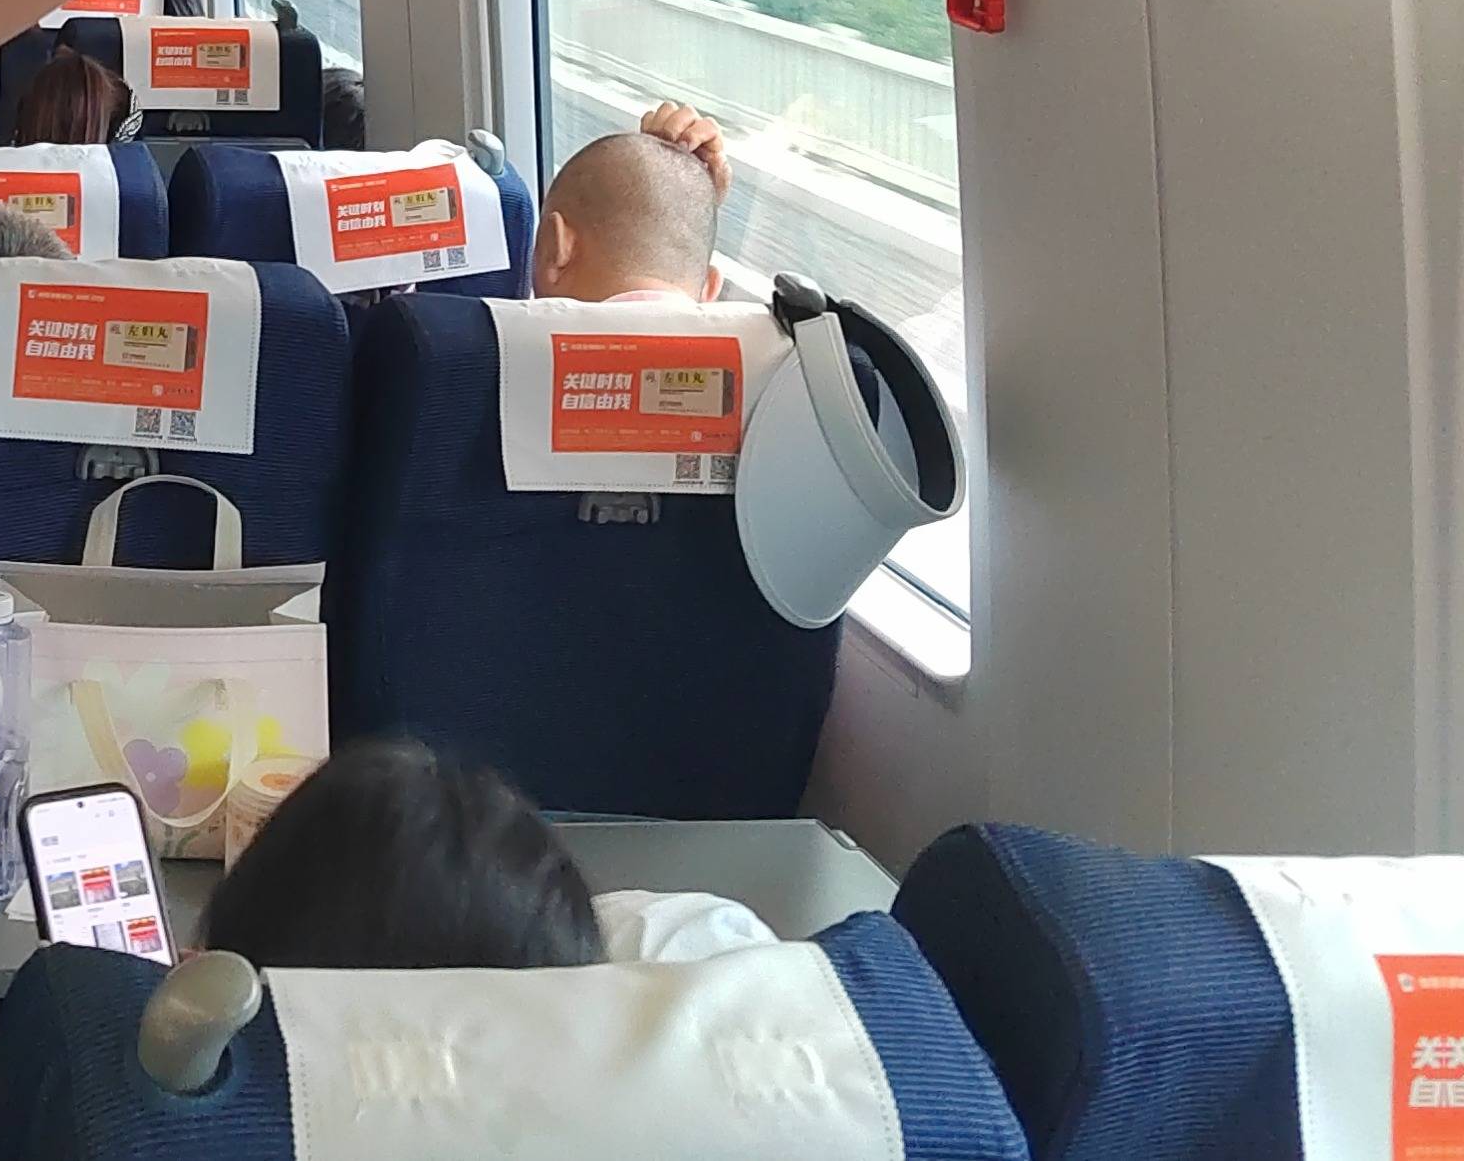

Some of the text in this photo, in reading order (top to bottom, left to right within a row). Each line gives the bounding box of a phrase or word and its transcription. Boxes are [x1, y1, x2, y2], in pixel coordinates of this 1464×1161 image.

[337, 200, 385, 218] 关键时刻
[28, 319, 98, 341] 关键时刻
[24, 339, 96, 361] 自信由我
[562, 372, 634, 391] 关键时刻
[561, 393, 632, 411] 自信由我
